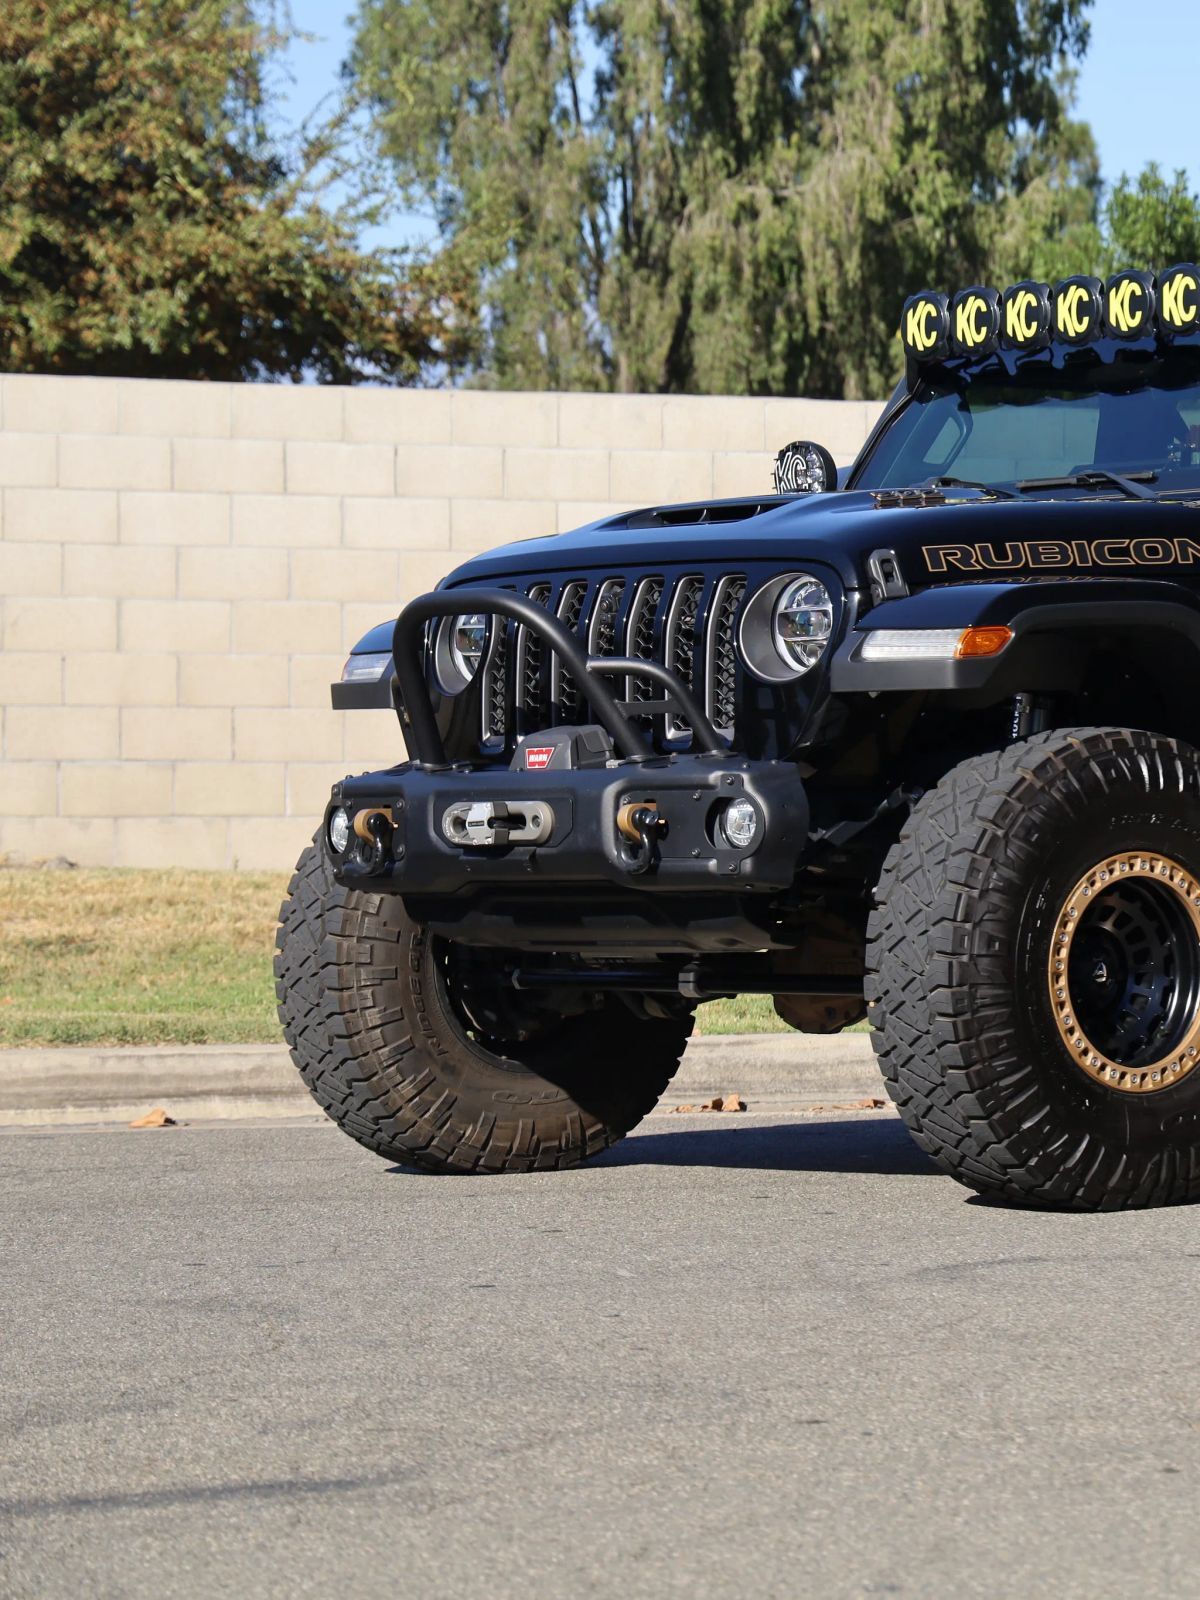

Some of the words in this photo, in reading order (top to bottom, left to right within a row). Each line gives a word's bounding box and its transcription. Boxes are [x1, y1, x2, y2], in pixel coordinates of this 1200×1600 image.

[956, 296, 987, 347] KC
[1006, 291, 1038, 342] KC
[1057, 285, 1089, 337] KC
[1109, 279, 1142, 332] KC
[1162, 273, 1197, 326] KC
[906, 300, 937, 351] KC
[775, 451, 807, 495] KC
[528, 753, 549, 763] WARN
[409, 975, 448, 1057] RIDGE
